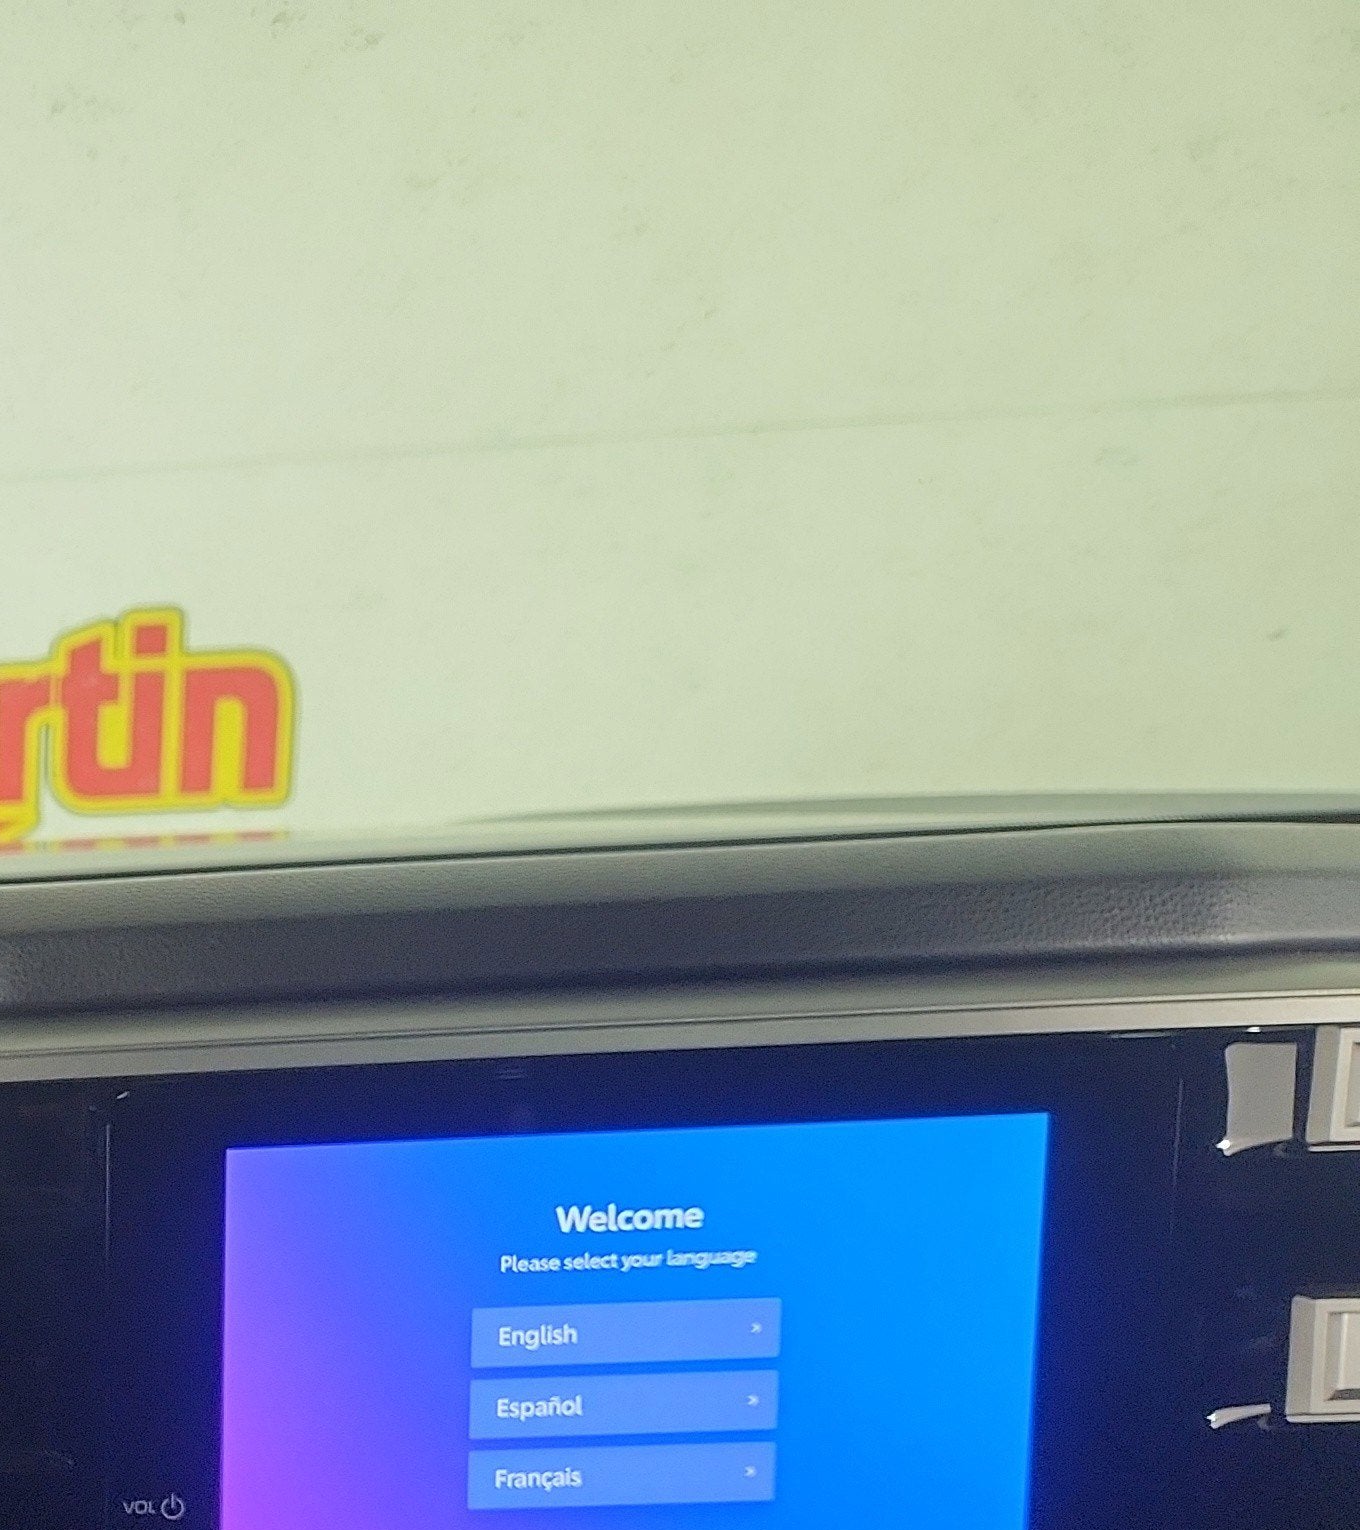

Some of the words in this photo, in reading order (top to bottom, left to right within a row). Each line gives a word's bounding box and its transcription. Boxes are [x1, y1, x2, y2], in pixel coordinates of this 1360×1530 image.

[555, 1202, 705, 1233] Welcome
[500, 1254, 560, 1274] Please
[563, 1252, 619, 1271] select
[621, 1254, 663, 1272] your
[666, 1249, 758, 1270] language
[498, 1323, 579, 1351] English
[496, 1395, 583, 1422] Español
[494, 1467, 583, 1492] Français
[123, 1500, 156, 1515] VOL
